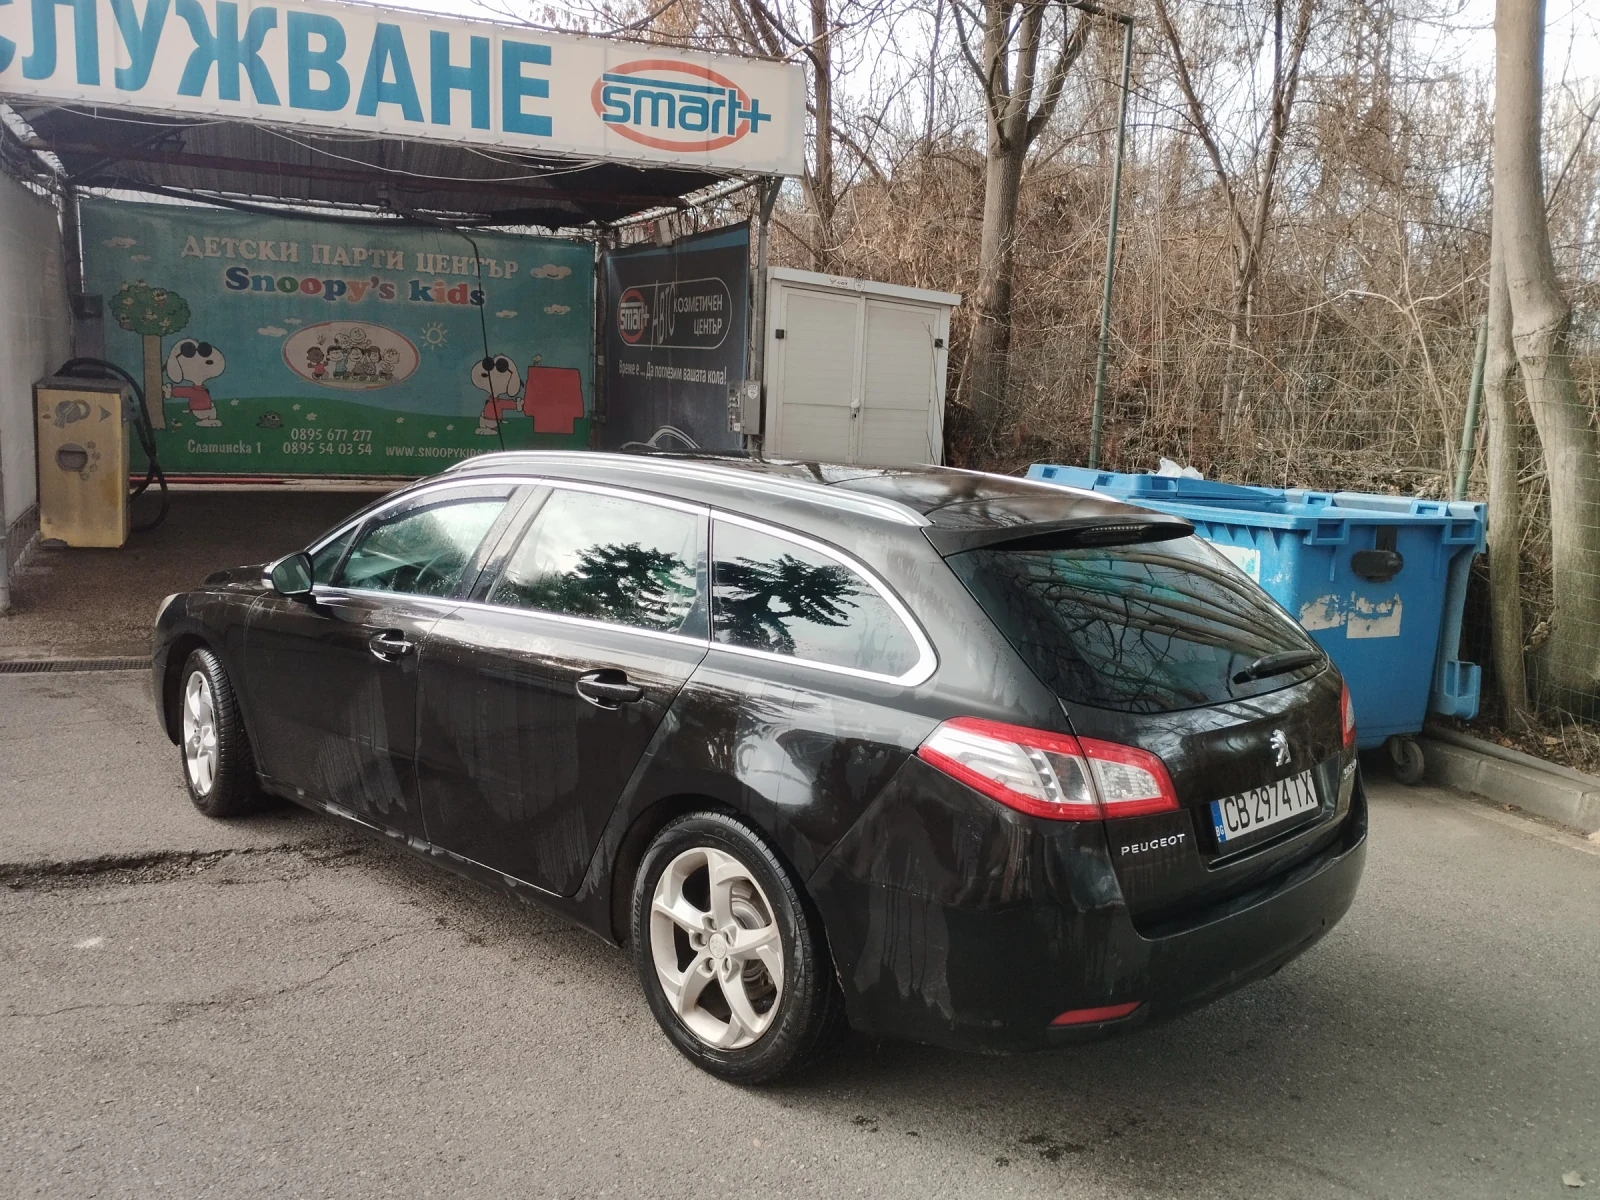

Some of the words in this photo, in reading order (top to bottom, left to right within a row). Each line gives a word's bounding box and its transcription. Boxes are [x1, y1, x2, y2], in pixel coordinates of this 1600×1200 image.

[0, 0, 553, 138] ЛУЖВАНЕ
[181, 235, 300, 263] ДЕТСКИ
[311, 244, 405, 271] ПАРТИ
[416, 252, 519, 279] ЦЕНТЪР
[225, 266, 396, 303] Snoopy's
[409, 279, 486, 306] kids
[673, 294, 723, 313] КОЗМЕТИЧЕН
[693, 317, 723, 337] ЦЕНТЪР
[683, 367, 707, 383] вашата
[707, 366, 727, 386] кола!
[291, 428, 323, 441] 0895
[327, 429, 348, 442] 677
[352, 429, 373, 442] 277
[187, 439, 251, 454] Слатинска
[256, 441, 262, 454] 1
[283, 441, 315, 455] 0895
[319, 442, 334, 455] 54
[338, 442, 353, 456] 03
[357, 443, 373, 456] 54
[1224, 794, 1251, 832] CB
[1250, 778, 1293, 824] 2974
[1290, 771, 1315, 808] TX
[1215, 824, 1225, 837] BG
[1121, 833, 1186, 856] PEUGEOT
